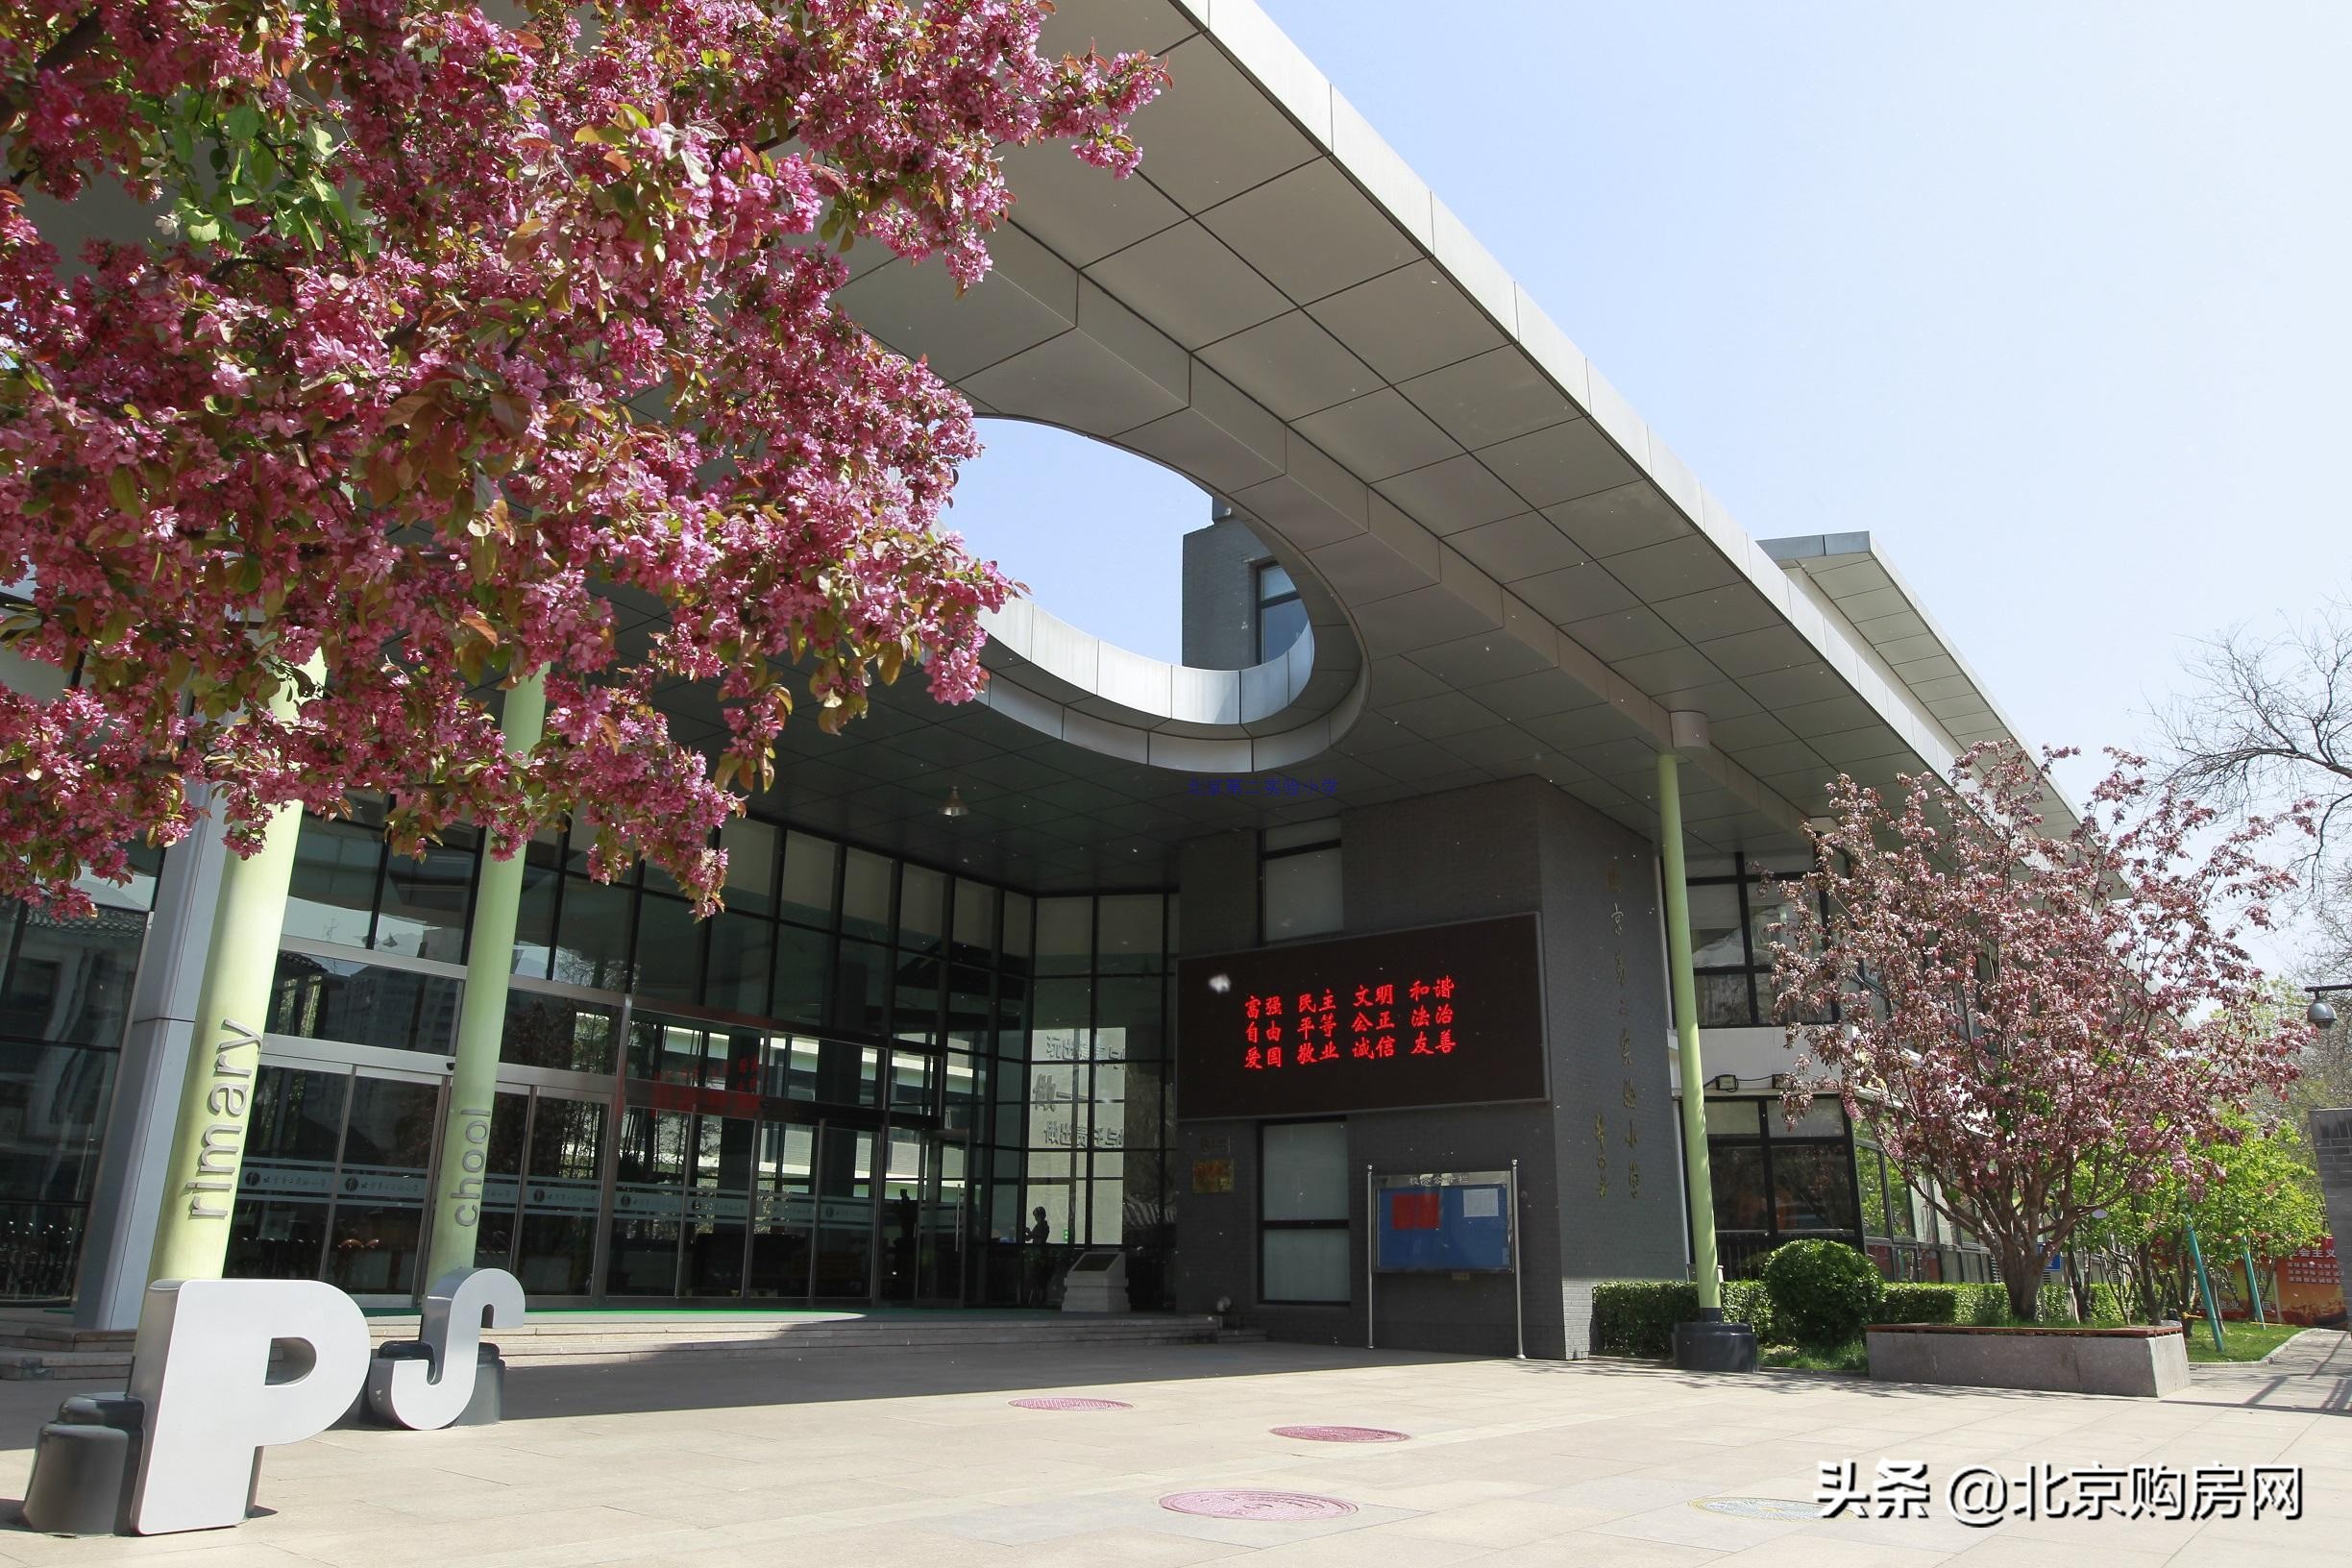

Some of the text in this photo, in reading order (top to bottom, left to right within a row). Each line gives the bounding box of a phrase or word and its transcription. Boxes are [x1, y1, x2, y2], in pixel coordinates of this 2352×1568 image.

[1245, 975, 1455, 1019] 富强 民主 文明 和谐
[1246, 1003, 1454, 1043] 自由 平等 公正 法治
[1245, 1028, 1457, 1069] 爱国 敬业 诚信 友善
[185, 1017, 263, 1219] rimary
[452, 1108, 492, 1226] chool
[131, 1279, 371, 1535] P
